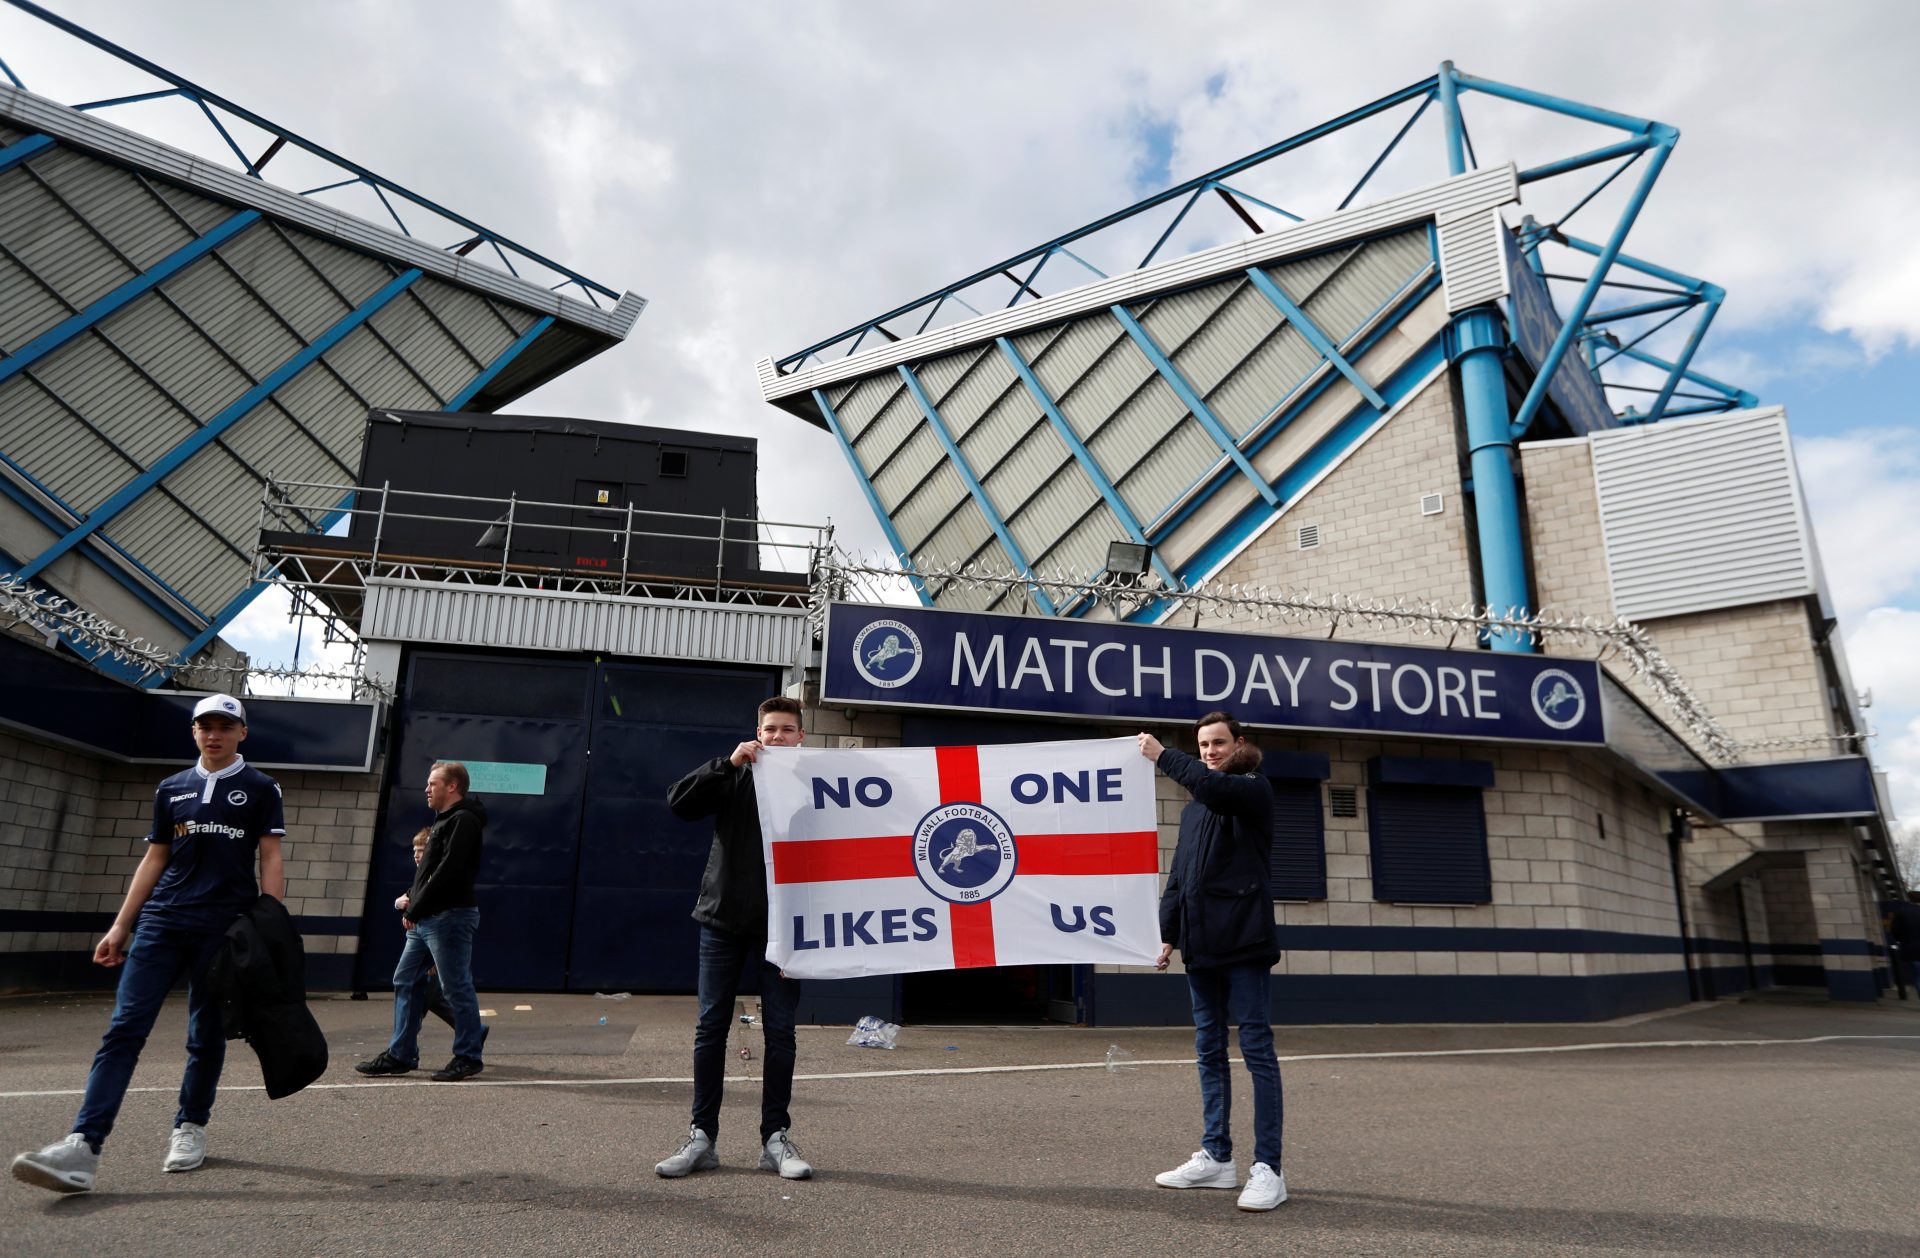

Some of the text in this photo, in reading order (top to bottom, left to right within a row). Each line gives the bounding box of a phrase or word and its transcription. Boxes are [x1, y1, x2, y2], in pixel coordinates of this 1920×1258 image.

[854, 620, 922, 656] MILLWALL FOOTBALL CLUB
[951, 632, 1171, 698] MATCH
[1195, 649, 1311, 706] DAY
[1329, 659, 1500, 719] STORE
[170, 792, 198, 803] macron
[812, 768, 1122, 809] NO ONE
[918, 808, 1012, 861] MILLWALL FOOTBALL CLUB
[960, 890, 980, 899] 1885
[794, 904, 1115, 950] LIKES US
